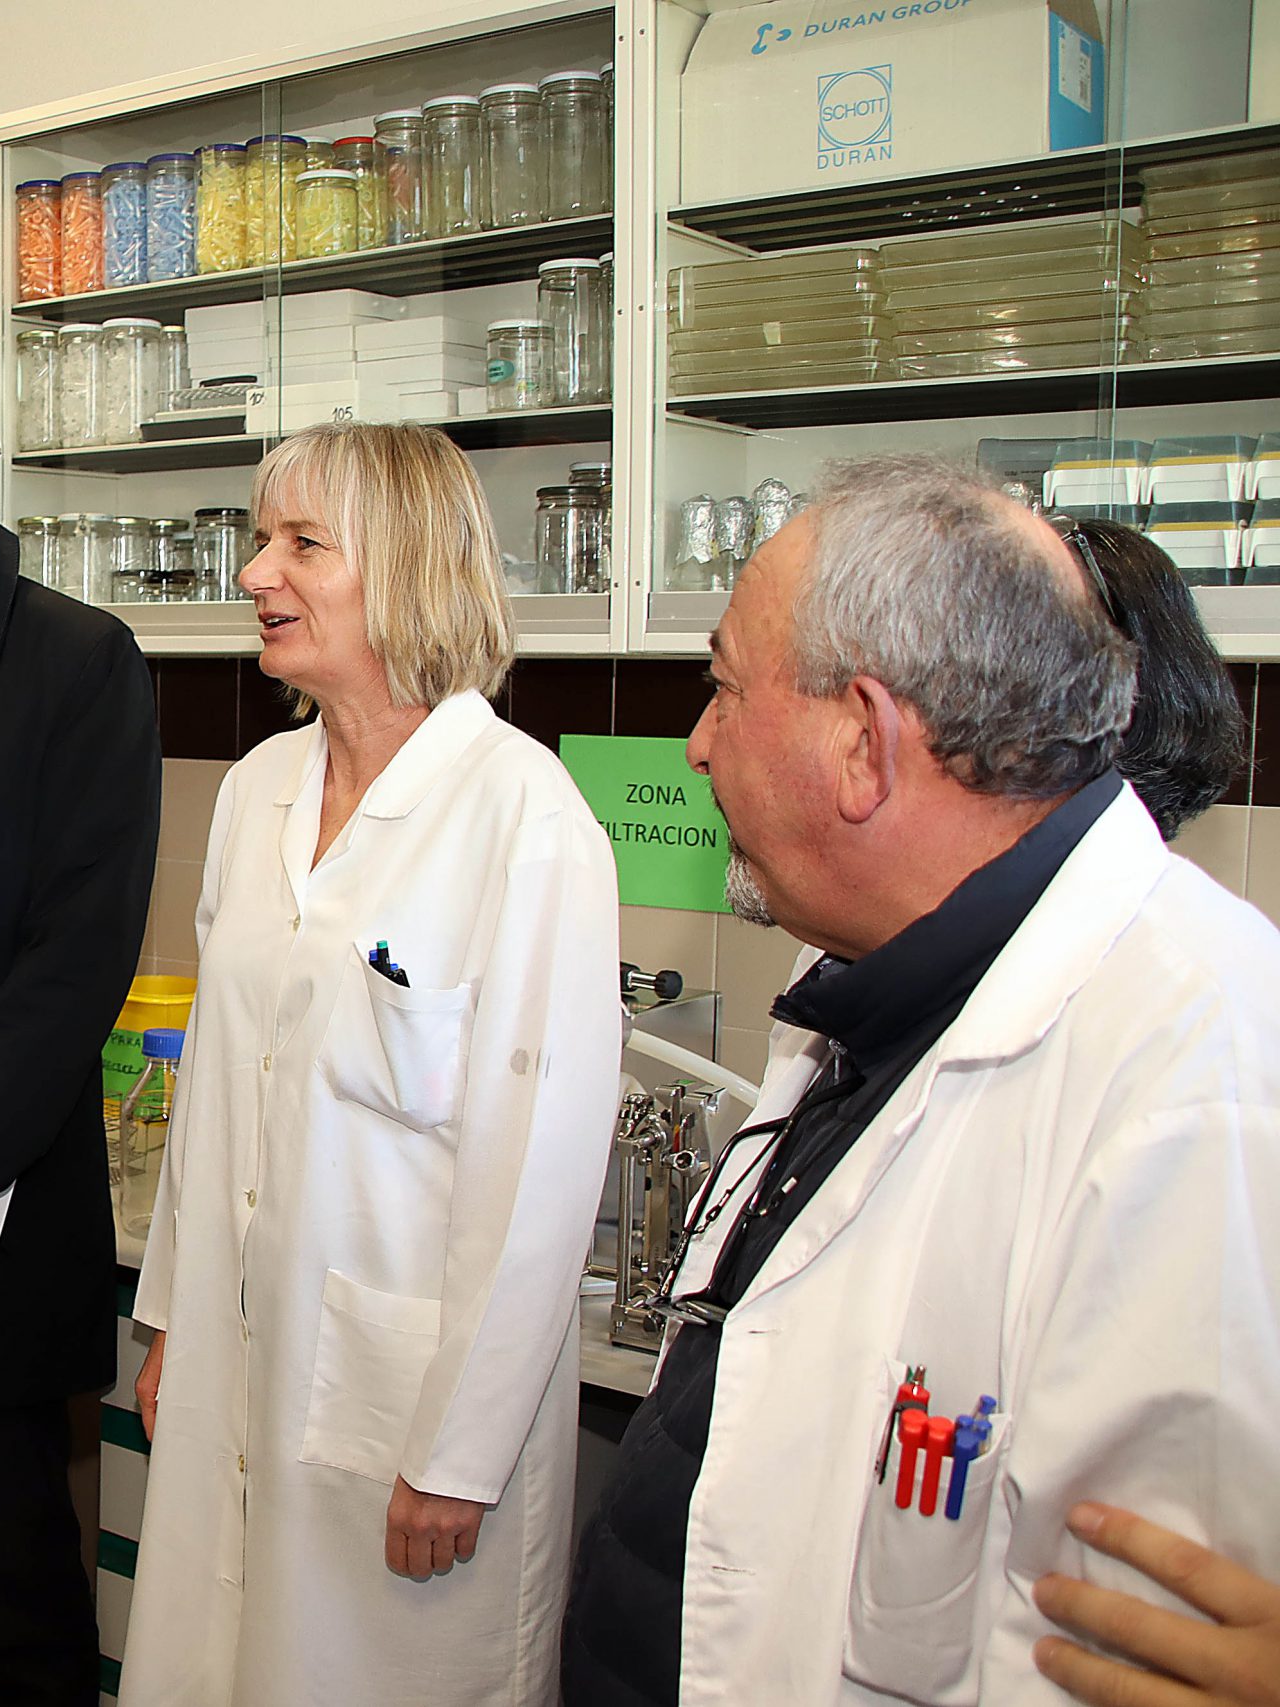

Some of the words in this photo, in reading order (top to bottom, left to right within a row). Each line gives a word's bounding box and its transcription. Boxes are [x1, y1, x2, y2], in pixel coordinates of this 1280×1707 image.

[804, 10, 886, 37] DURAN
[822, 97, 886, 121] SCHOTT
[817, 145, 892, 169] DURAN
[332, 406, 353, 423] 105
[626, 783, 687, 806] ZONA
[598, 820, 717, 848] ILTRACION
